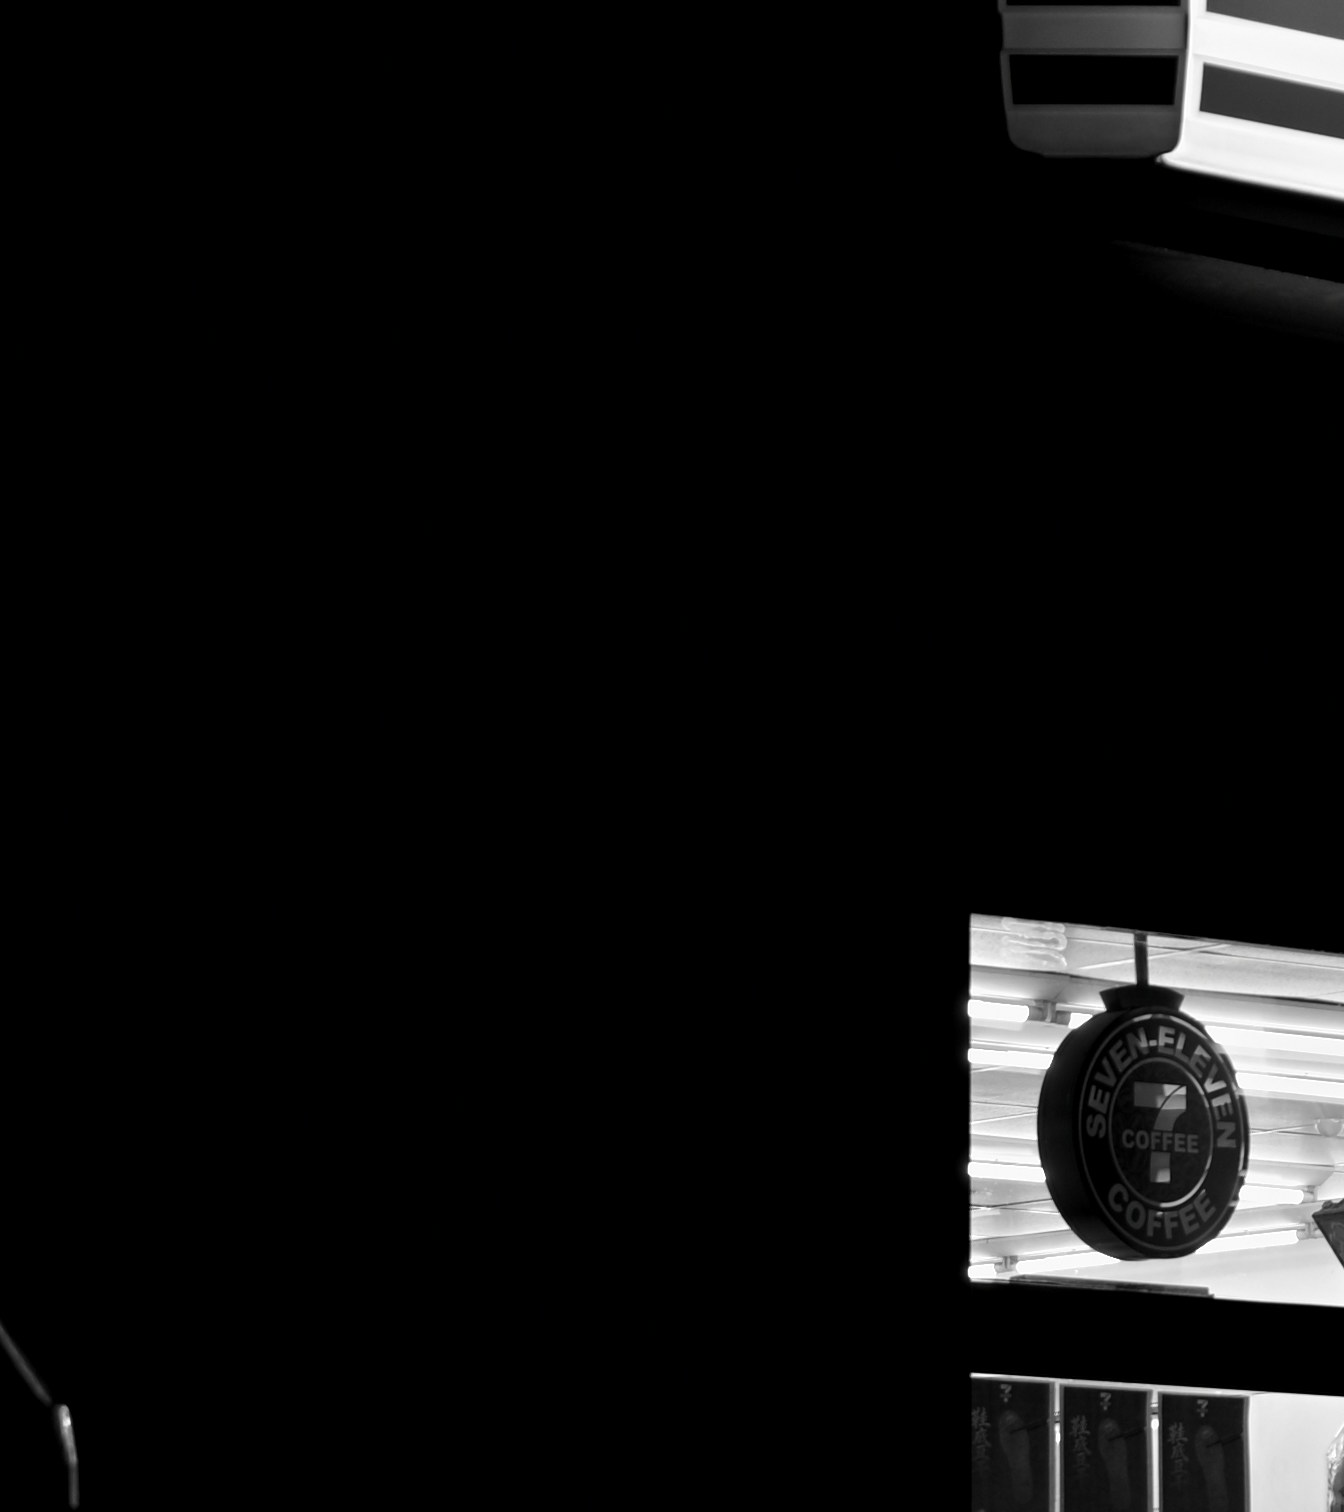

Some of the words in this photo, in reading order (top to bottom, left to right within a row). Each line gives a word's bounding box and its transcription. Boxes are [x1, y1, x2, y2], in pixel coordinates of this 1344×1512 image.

[1085, 1025, 1237, 1149] SEVEN-ELEVEN
[1121, 1128, 1200, 1154] COFFEE
[1107, 1182, 1217, 1239] COFFEE
